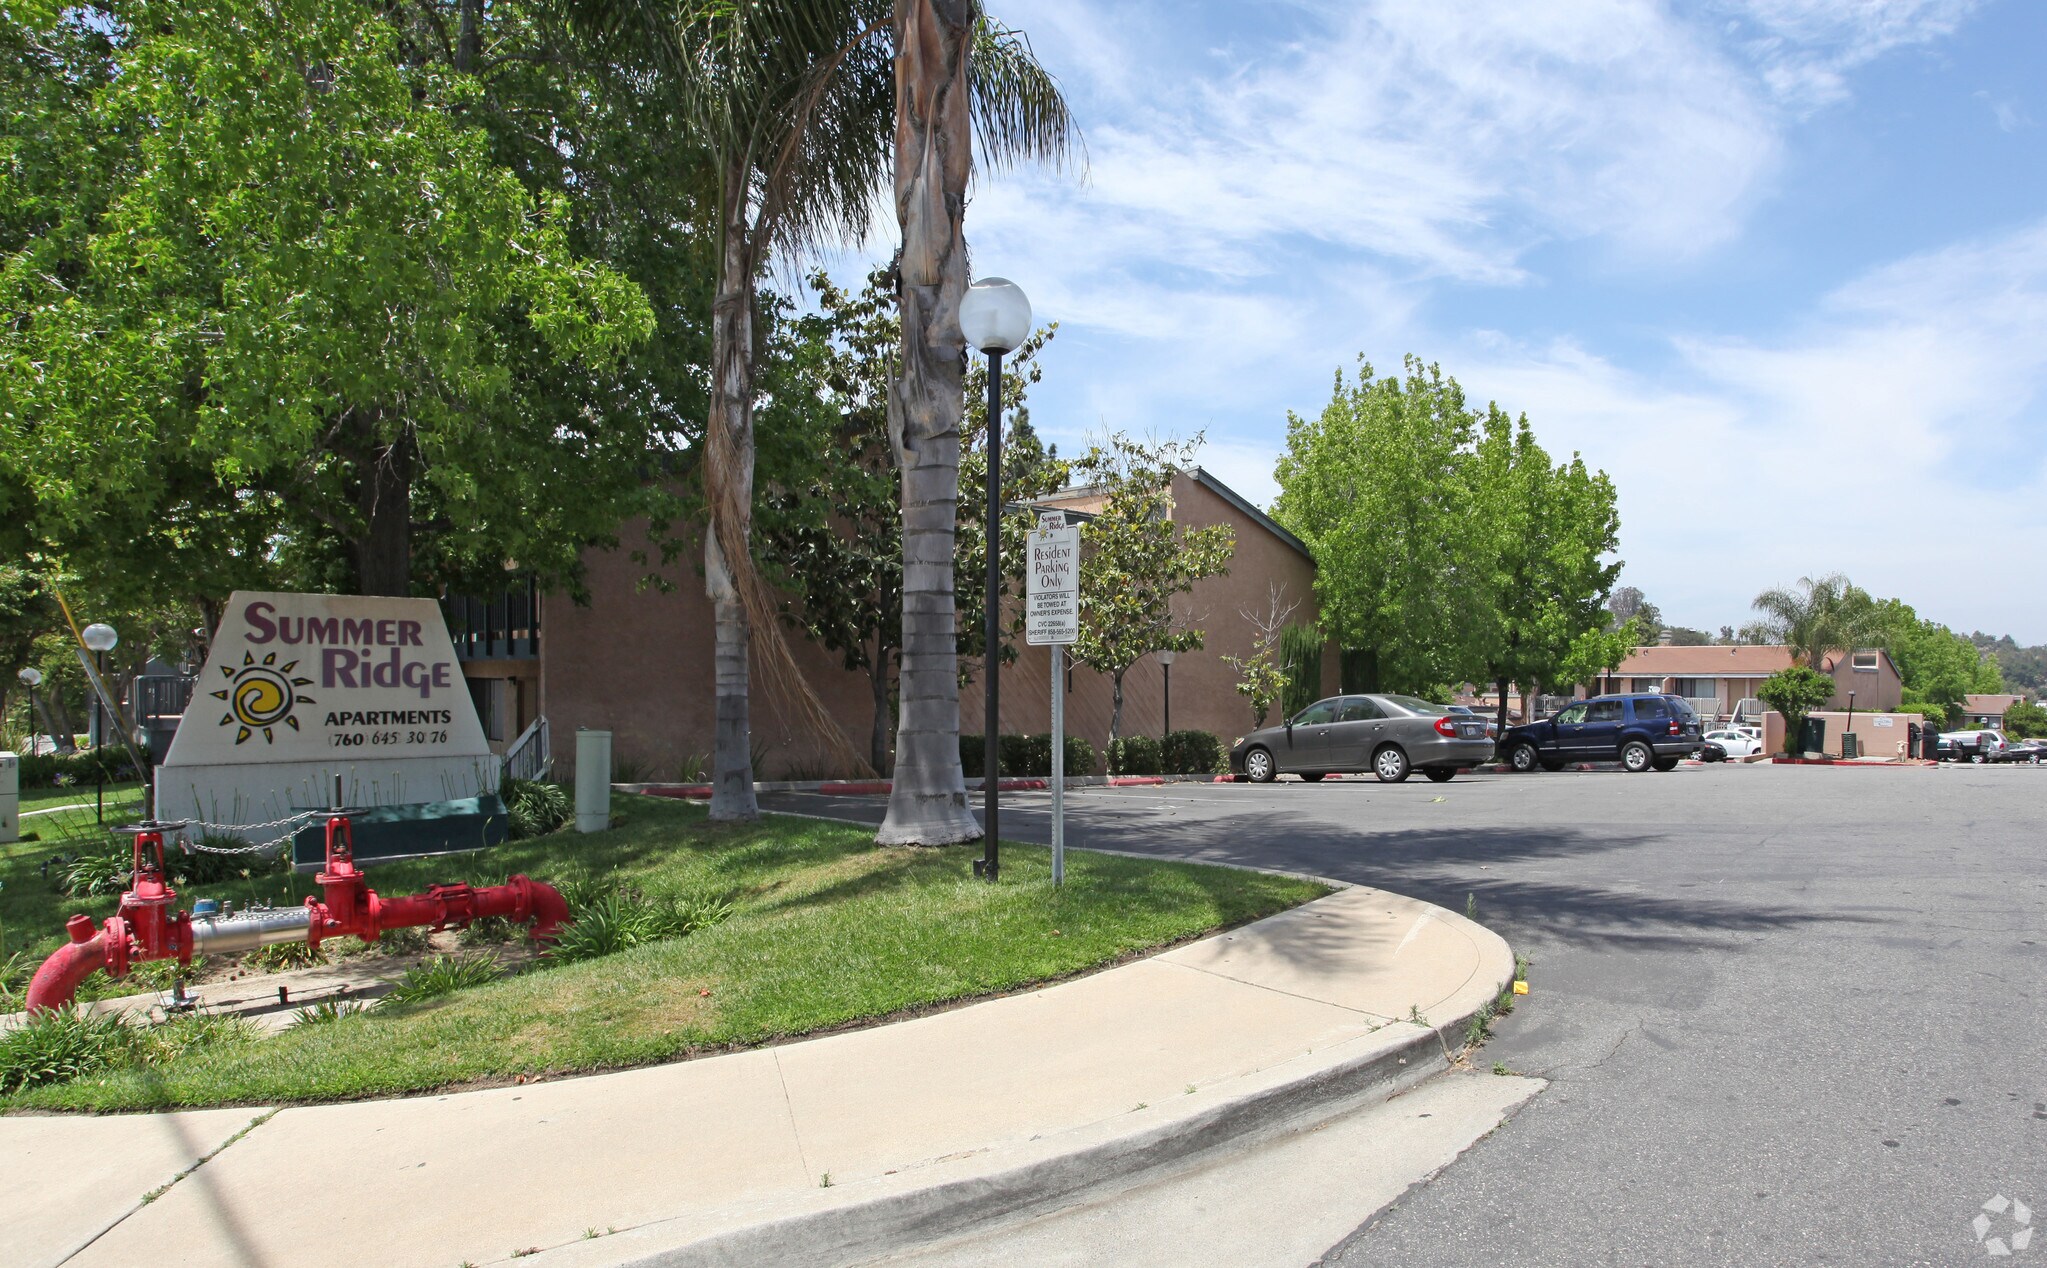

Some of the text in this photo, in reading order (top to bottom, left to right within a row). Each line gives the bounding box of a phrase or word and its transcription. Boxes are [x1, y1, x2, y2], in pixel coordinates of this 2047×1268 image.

[1034, 593, 1059, 601] VIOLATORS
[1030, 609, 1050, 617] OWNER'S
[244, 601, 424, 647] SUMMER
[324, 709, 452, 726] APARTMENTS
[371, 730, 398, 745] 645
